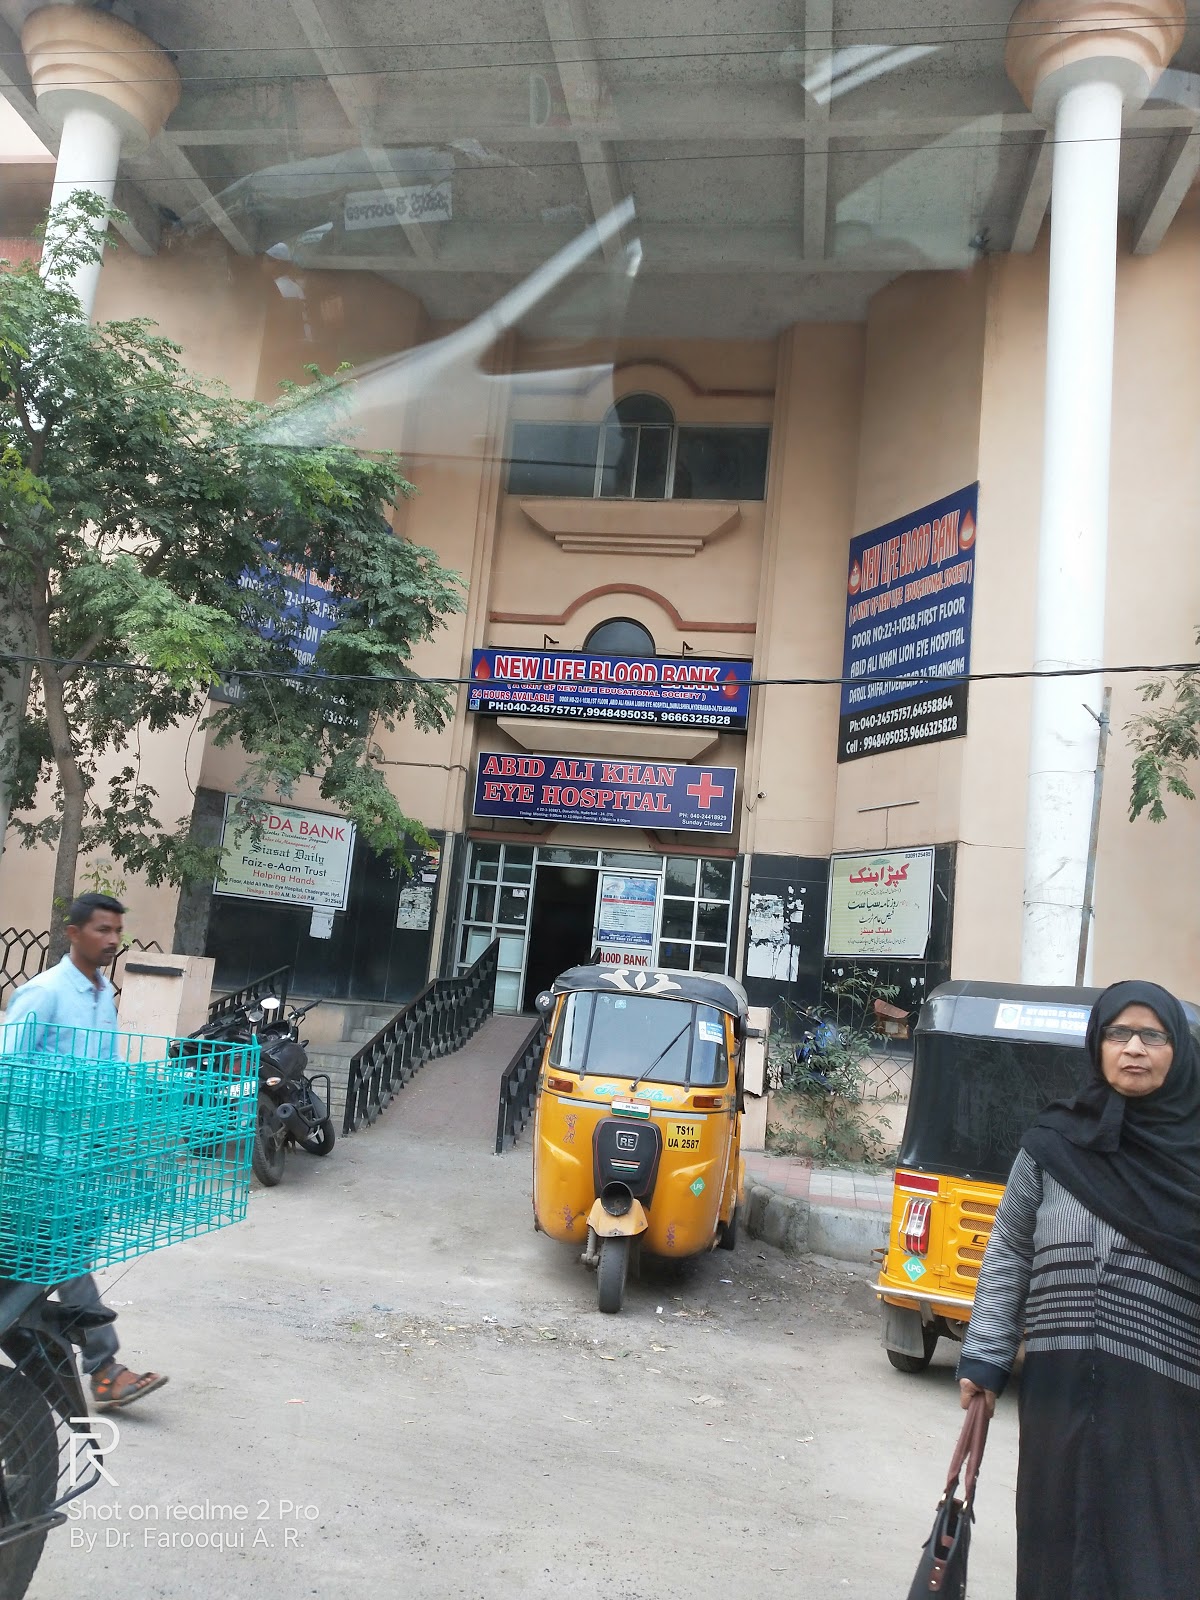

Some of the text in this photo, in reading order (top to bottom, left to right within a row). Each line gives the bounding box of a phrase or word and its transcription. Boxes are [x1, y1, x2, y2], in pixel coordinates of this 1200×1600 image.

[860, 509, 960, 593] NEW LIFE BLOOD BANK
[905, 570, 943, 603] EDUCATIONAL
[852, 628, 872, 650] DOOR
[939, 596, 965, 622] FLOOR
[850, 627, 965, 679] ABID ALI KHAN LION EYE HOSPITAL
[494, 655, 720, 691] NEW LIFE BLOOD BANK
[223, 683, 240, 699] Cell
[472, 689, 555, 703] 24 HOURS AVAILABLE
[599, 686, 660, 698] EDUCATIONAL
[488, 701, 731, 725] PH:040-24575757,9948495035, 9666325828
[849, 695, 954, 733] Ph:040-24575757,64558864
[846, 739, 858, 754] Cell
[863, 716, 957, 750] 9948495035,9666325828
[483, 756, 677, 787] ABID ALI KHAN
[483, 781, 672, 813] EYE HOSPITAL
[299, 820, 345, 841] BANK
[682, 819, 702, 827] Sunday
[249, 842, 325, 866] Siasat Daily
[242, 856, 327, 877] Faiz-e-Aam Trust
[253, 869, 316, 886] Helping Hands
[623, 954, 648, 966] BANK
[676, 1126, 694, 1136] TS11
[620, 1137, 634, 1147] RE
[667, 1138, 700, 1149] UA 2587
[907, 1263, 922, 1274] LPG
